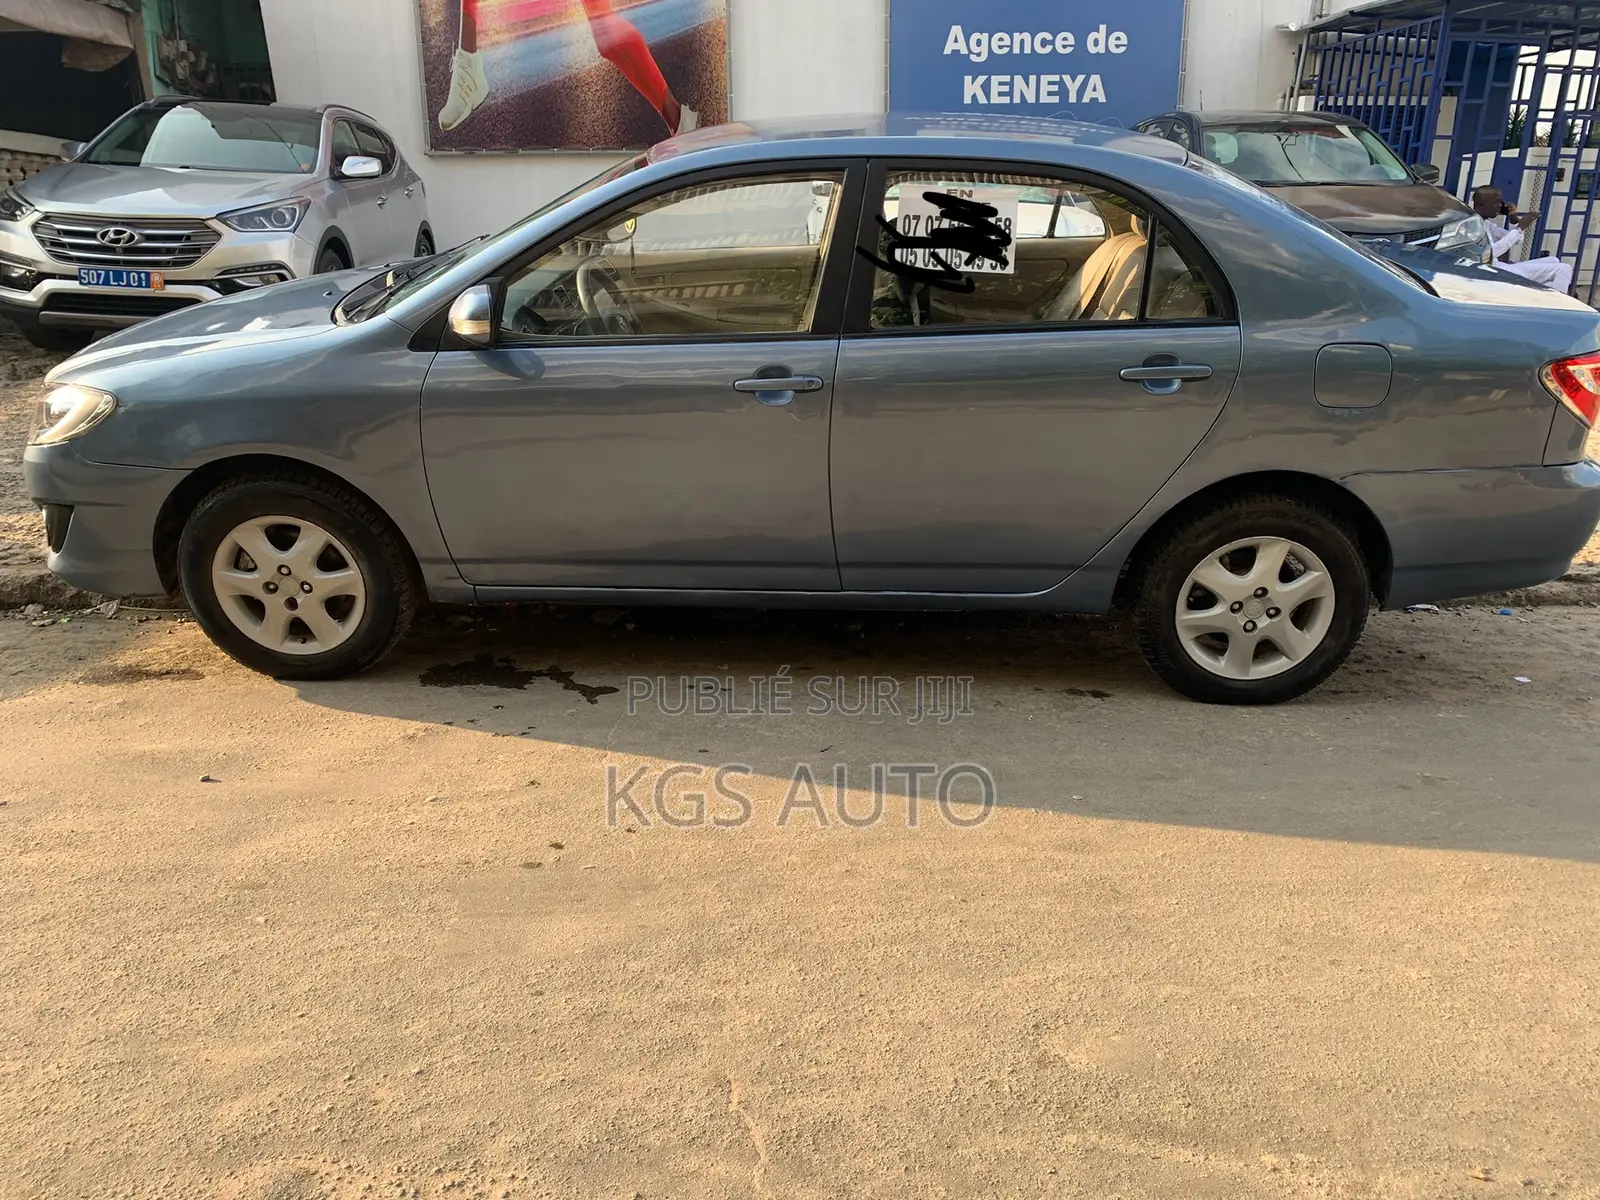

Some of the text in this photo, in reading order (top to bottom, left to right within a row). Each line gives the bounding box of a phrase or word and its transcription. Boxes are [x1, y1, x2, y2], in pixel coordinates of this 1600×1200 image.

[943, 24, 1128, 62] Agence de
[963, 74, 1107, 104] KENEYA
[946, 189, 974, 199] EN
[902, 213, 921, 237] 07
[80, 269, 146, 287] 507 LJ 01
